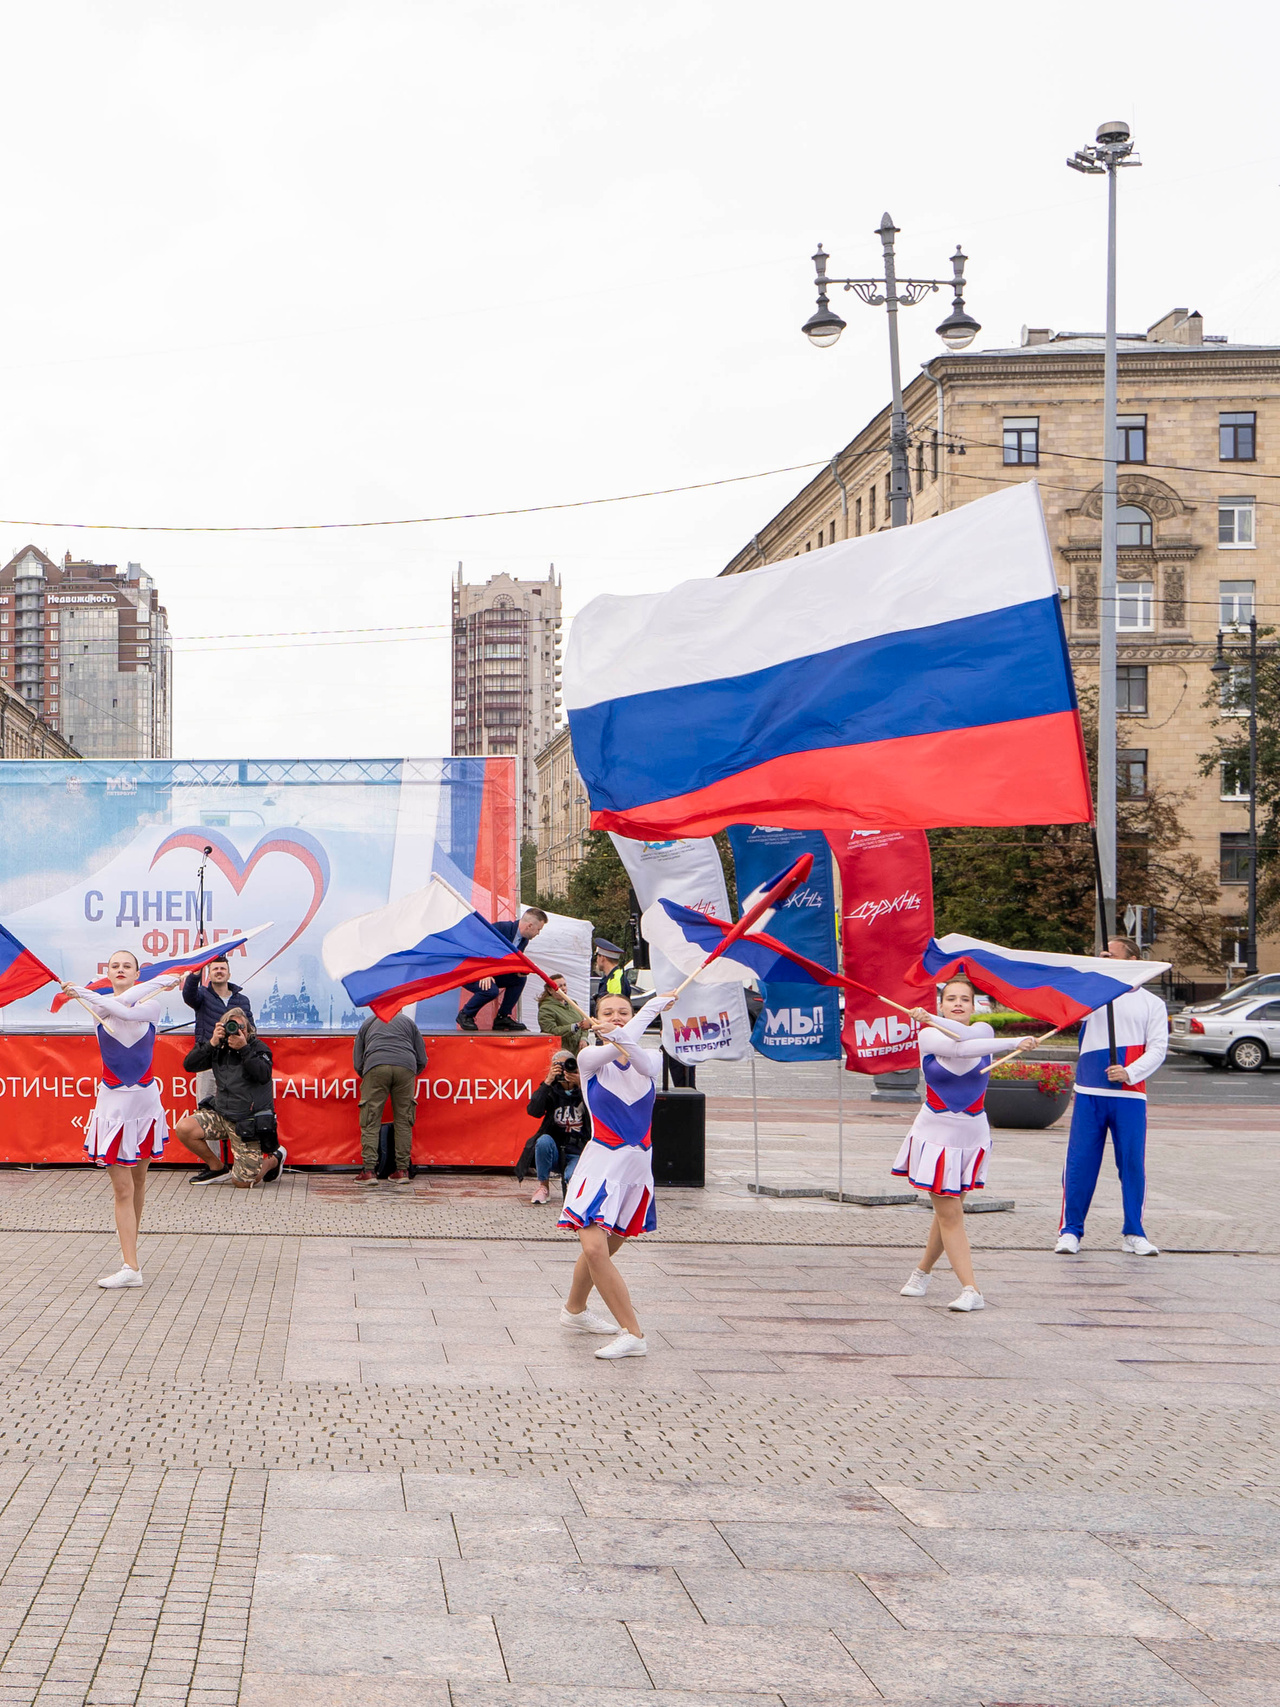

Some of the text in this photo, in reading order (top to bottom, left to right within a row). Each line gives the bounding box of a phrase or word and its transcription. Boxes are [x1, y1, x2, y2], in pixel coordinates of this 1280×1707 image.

[47, 594, 117, 604] Недвижимость
[84, 890, 213, 927] С ДНЕМ
[142, 929, 247, 957] ФЛАГА
[675, 1038, 732, 1054] ПЕТЕРБУРГ
[763, 1035, 824, 1046] ПЕТЕРБУРГ
[857, 1040, 919, 1058] ПЕТЕРБУРГ
